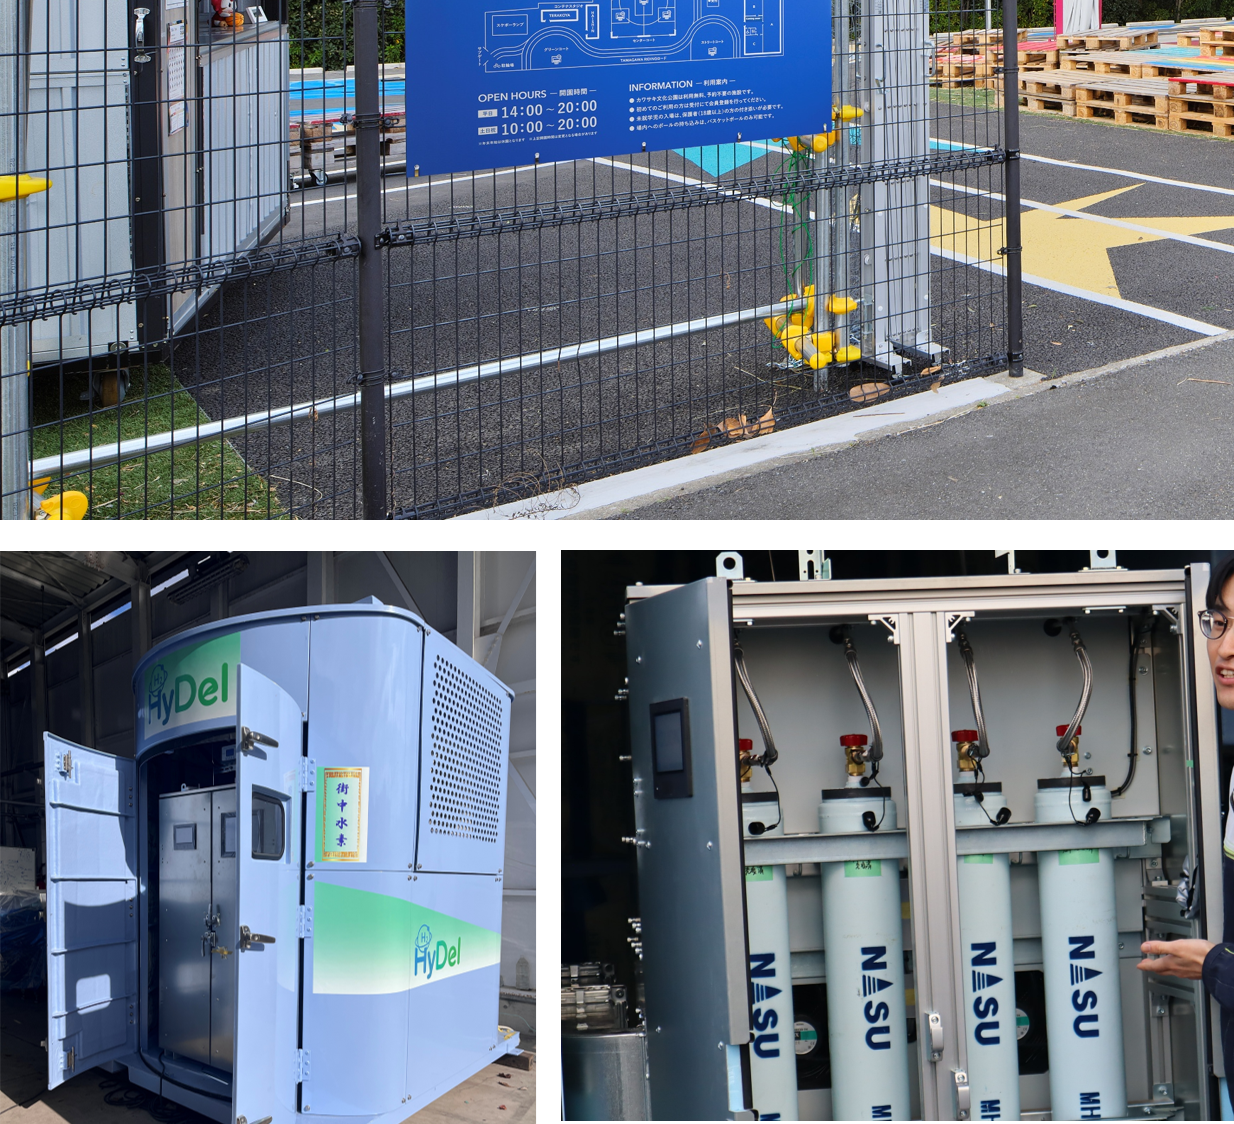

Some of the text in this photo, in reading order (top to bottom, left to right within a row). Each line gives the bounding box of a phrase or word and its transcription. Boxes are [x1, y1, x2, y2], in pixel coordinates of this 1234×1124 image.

[478, 88, 588, 102] OPEN HOURS 開園時間
[501, 104, 543, 118] 14:00
[558, 99, 597, 114] 20:00
[629, 78, 728, 92] INFORMATION 利用案内
[501, 120, 543, 136] 10:00
[558, 116, 597, 131] 20:00
[148, 662, 229, 726] HyDel
[335, 782, 349, 847] 街中水素
[414, 936, 461, 979] HyDel
[1068, 935, 1103, 1038] NASU
[750, 953, 783, 1059] NASU
[860, 946, 894, 1050] NASU
[971, 941, 1004, 1046] NASU
